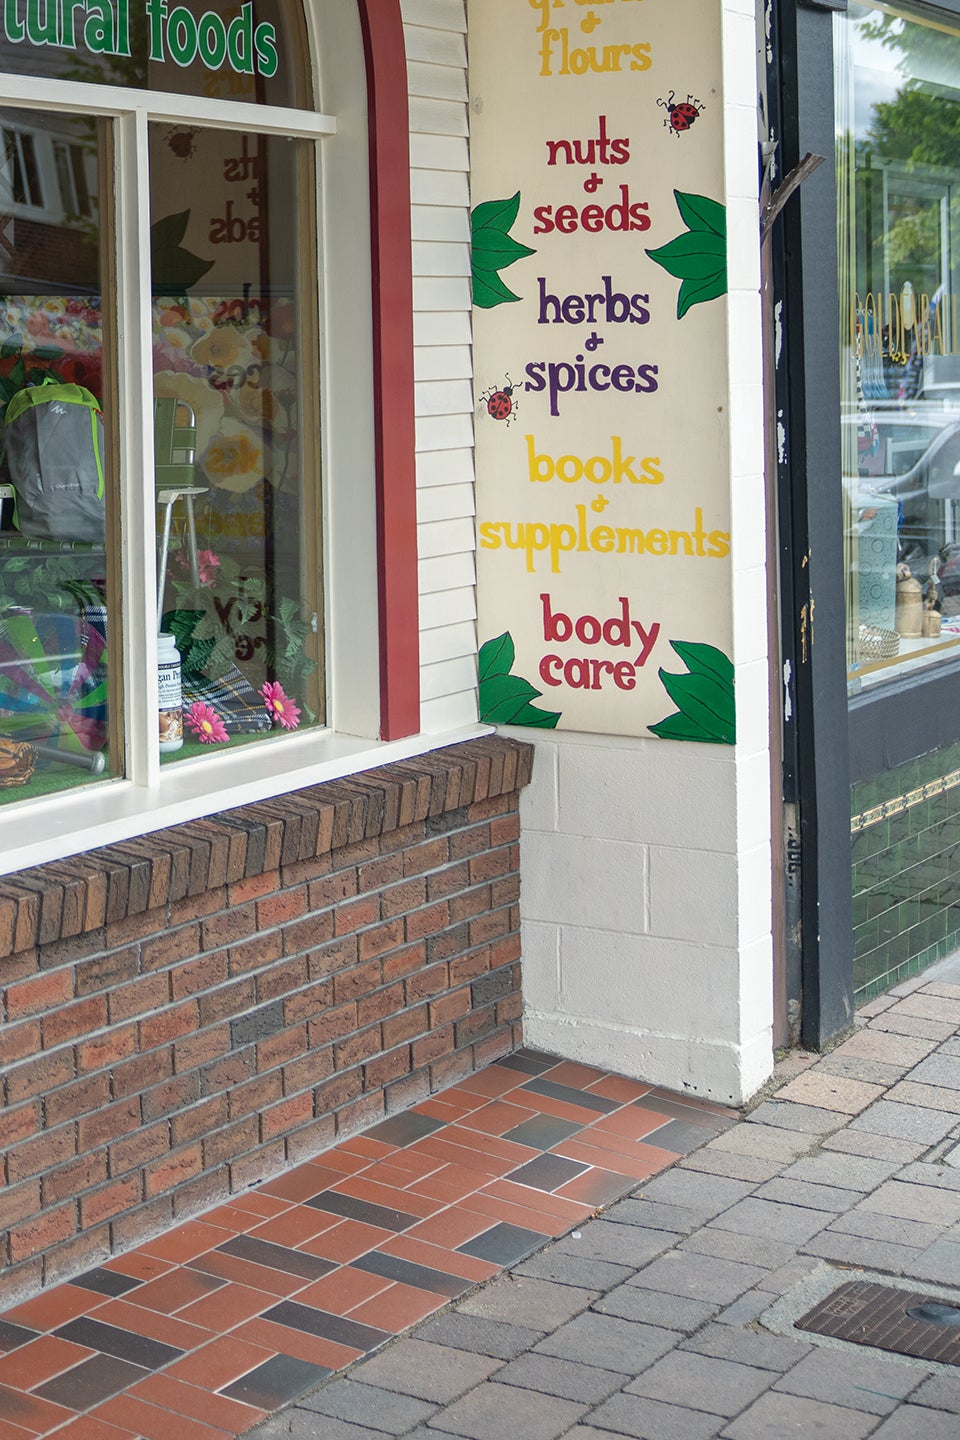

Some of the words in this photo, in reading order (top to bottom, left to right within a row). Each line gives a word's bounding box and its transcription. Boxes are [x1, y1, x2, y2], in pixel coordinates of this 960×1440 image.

[538, 28, 653, 77] flours
[546, 115, 630, 166] nuts
[533, 184, 652, 235] seeds
[537, 275, 651, 325] herbs
[524, 354, 660, 417] spices
[524, 434, 665, 486] books
[479, 504, 731, 574] supplements
[539, 592, 662, 667] body
[539, 652, 638, 691] care
